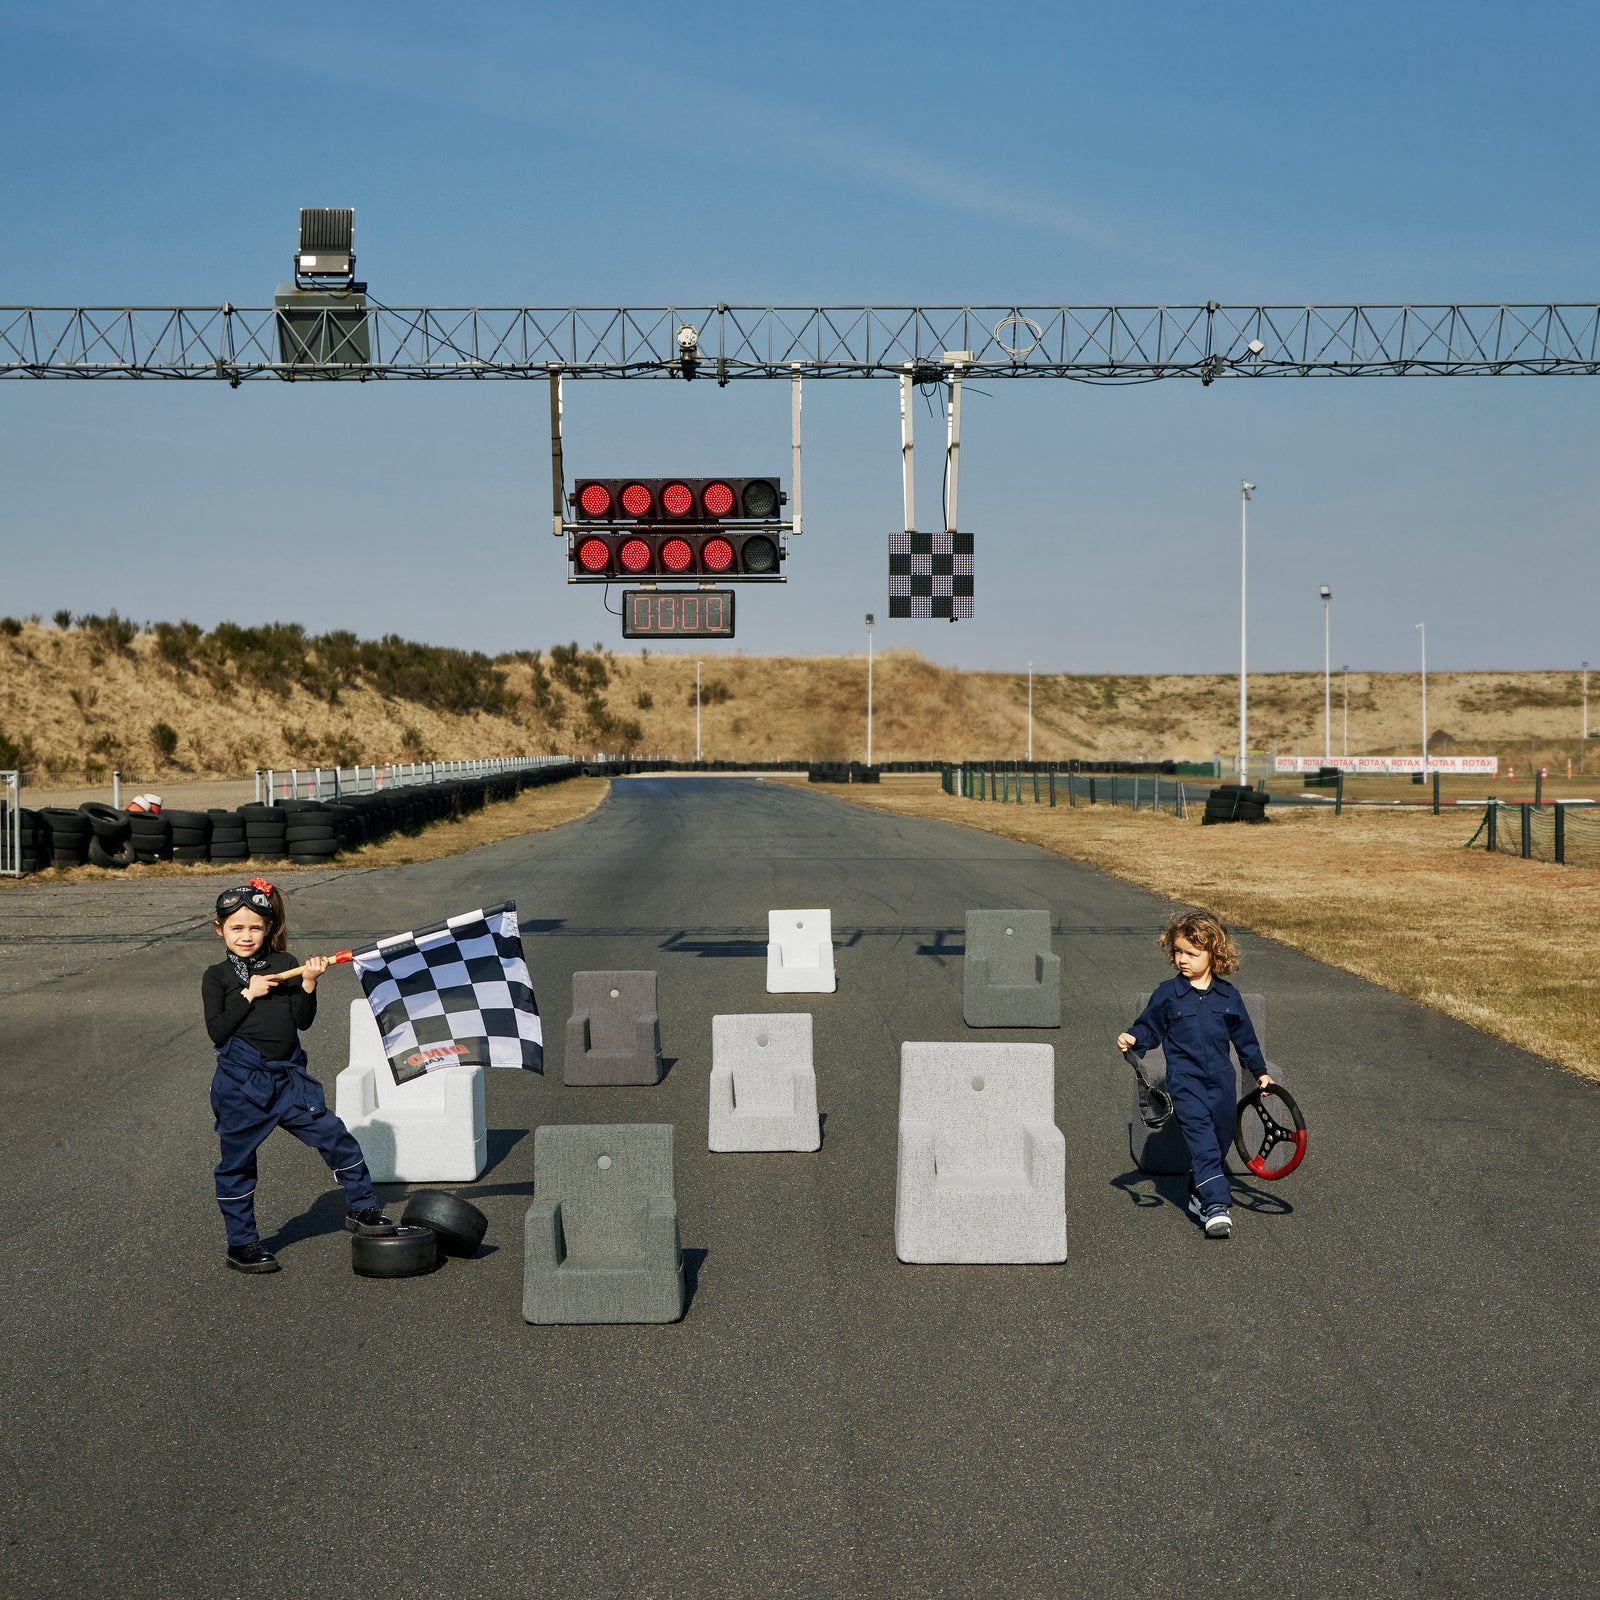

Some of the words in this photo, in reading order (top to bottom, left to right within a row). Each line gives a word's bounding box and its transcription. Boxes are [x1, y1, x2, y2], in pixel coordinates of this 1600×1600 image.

[1358, 759, 1386, 767] ROTAX
[1391, 759, 1420, 767] ROTAX
[1462, 759, 1493, 767] ROTAX
